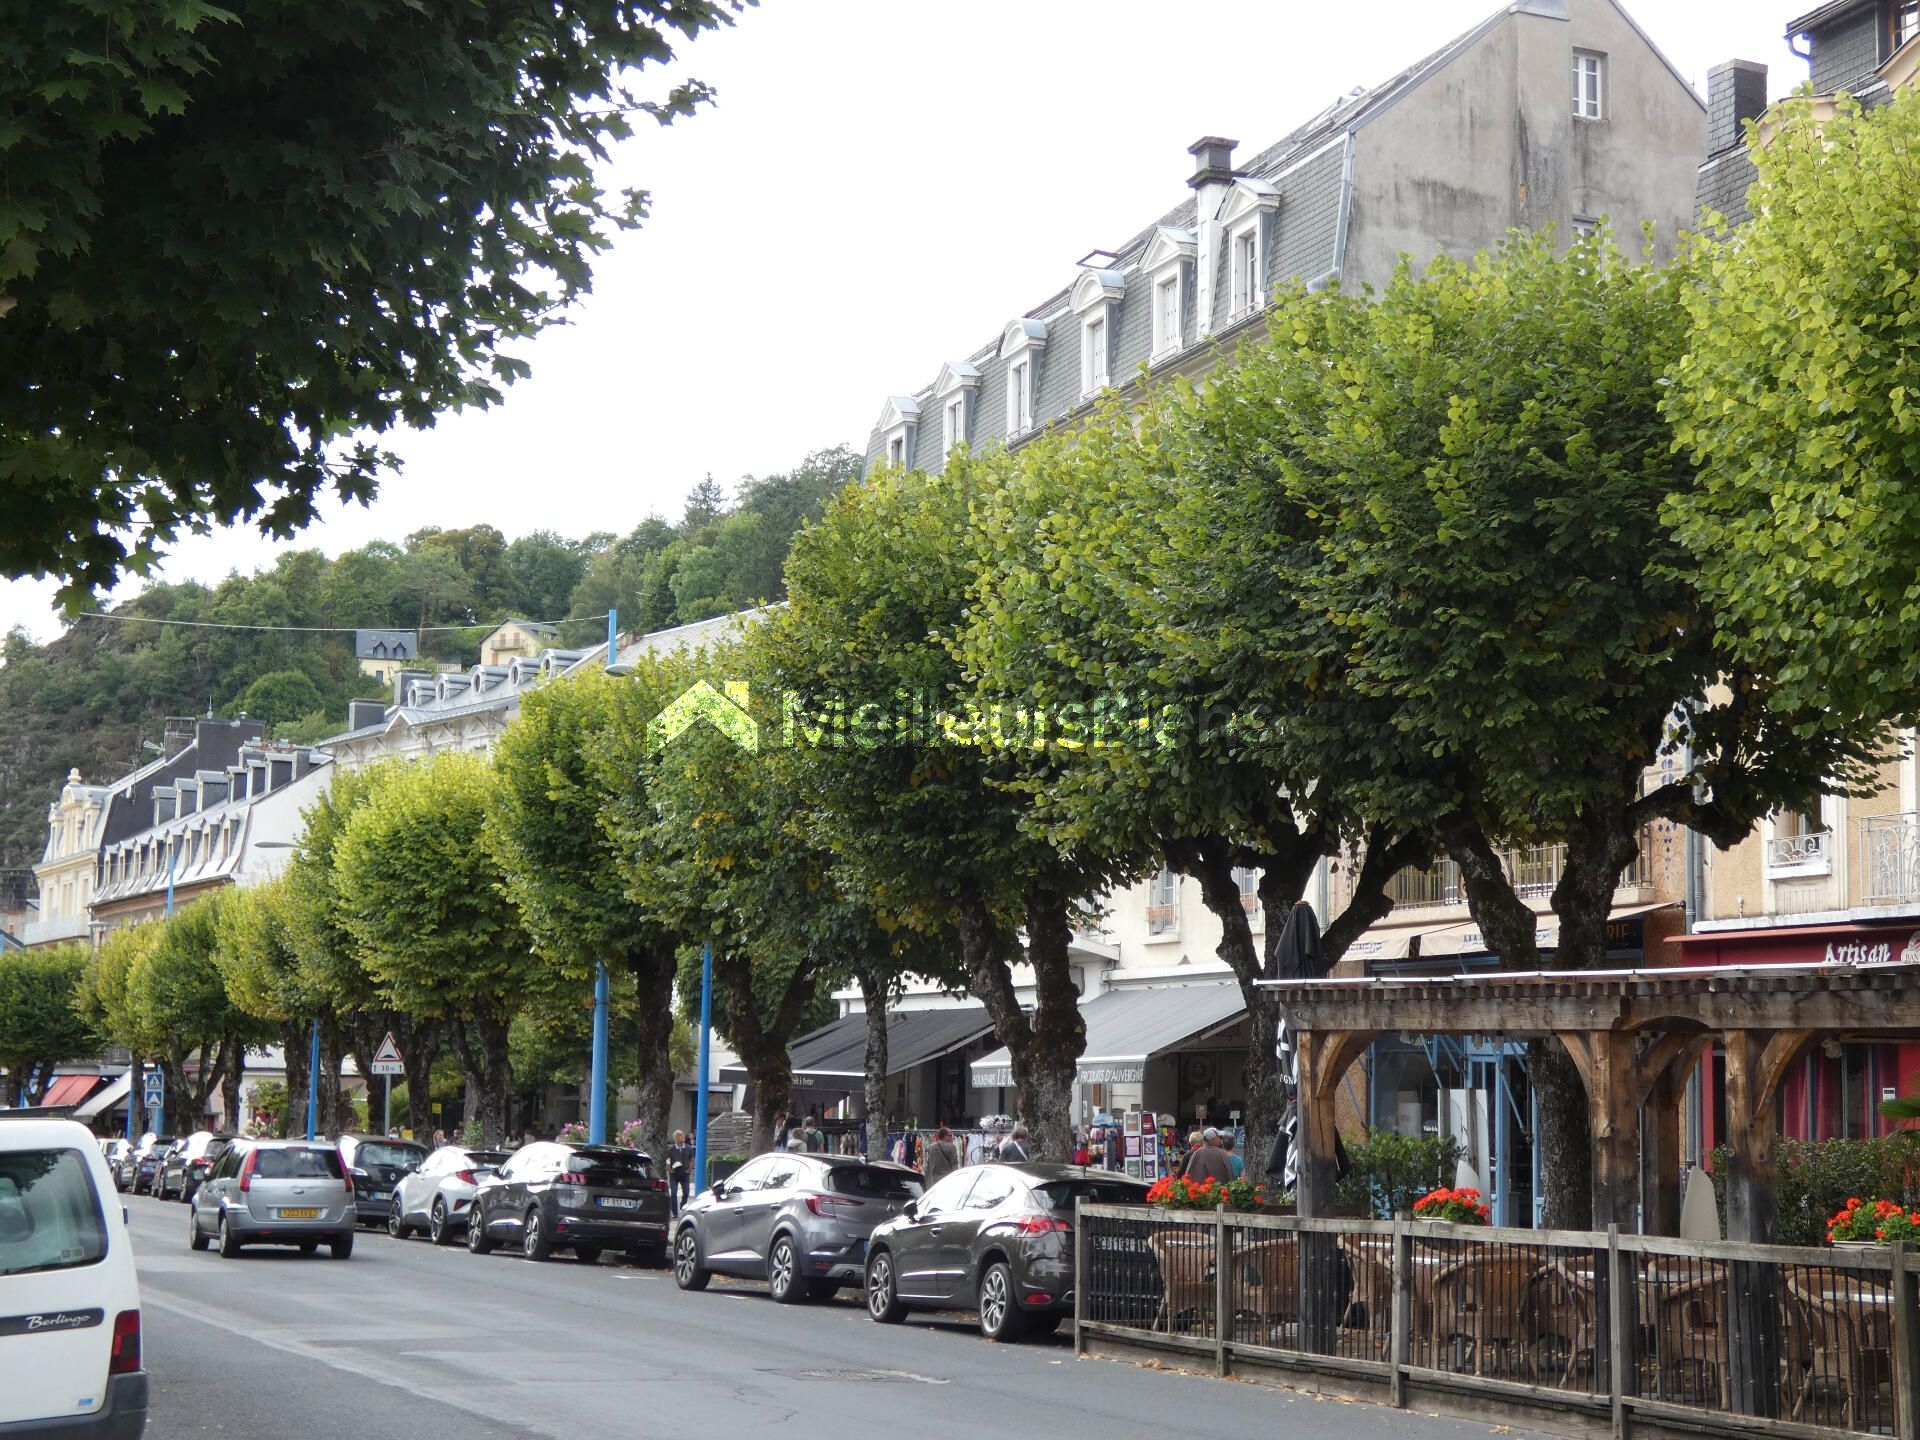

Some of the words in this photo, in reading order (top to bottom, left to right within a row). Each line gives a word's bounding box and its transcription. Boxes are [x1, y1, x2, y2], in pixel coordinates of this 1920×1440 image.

[1822, 938, 1892, 962] Artisan
[1079, 1069, 1105, 1083] PRODUITS
[26, 1313, 91, 1330] Berlingo
